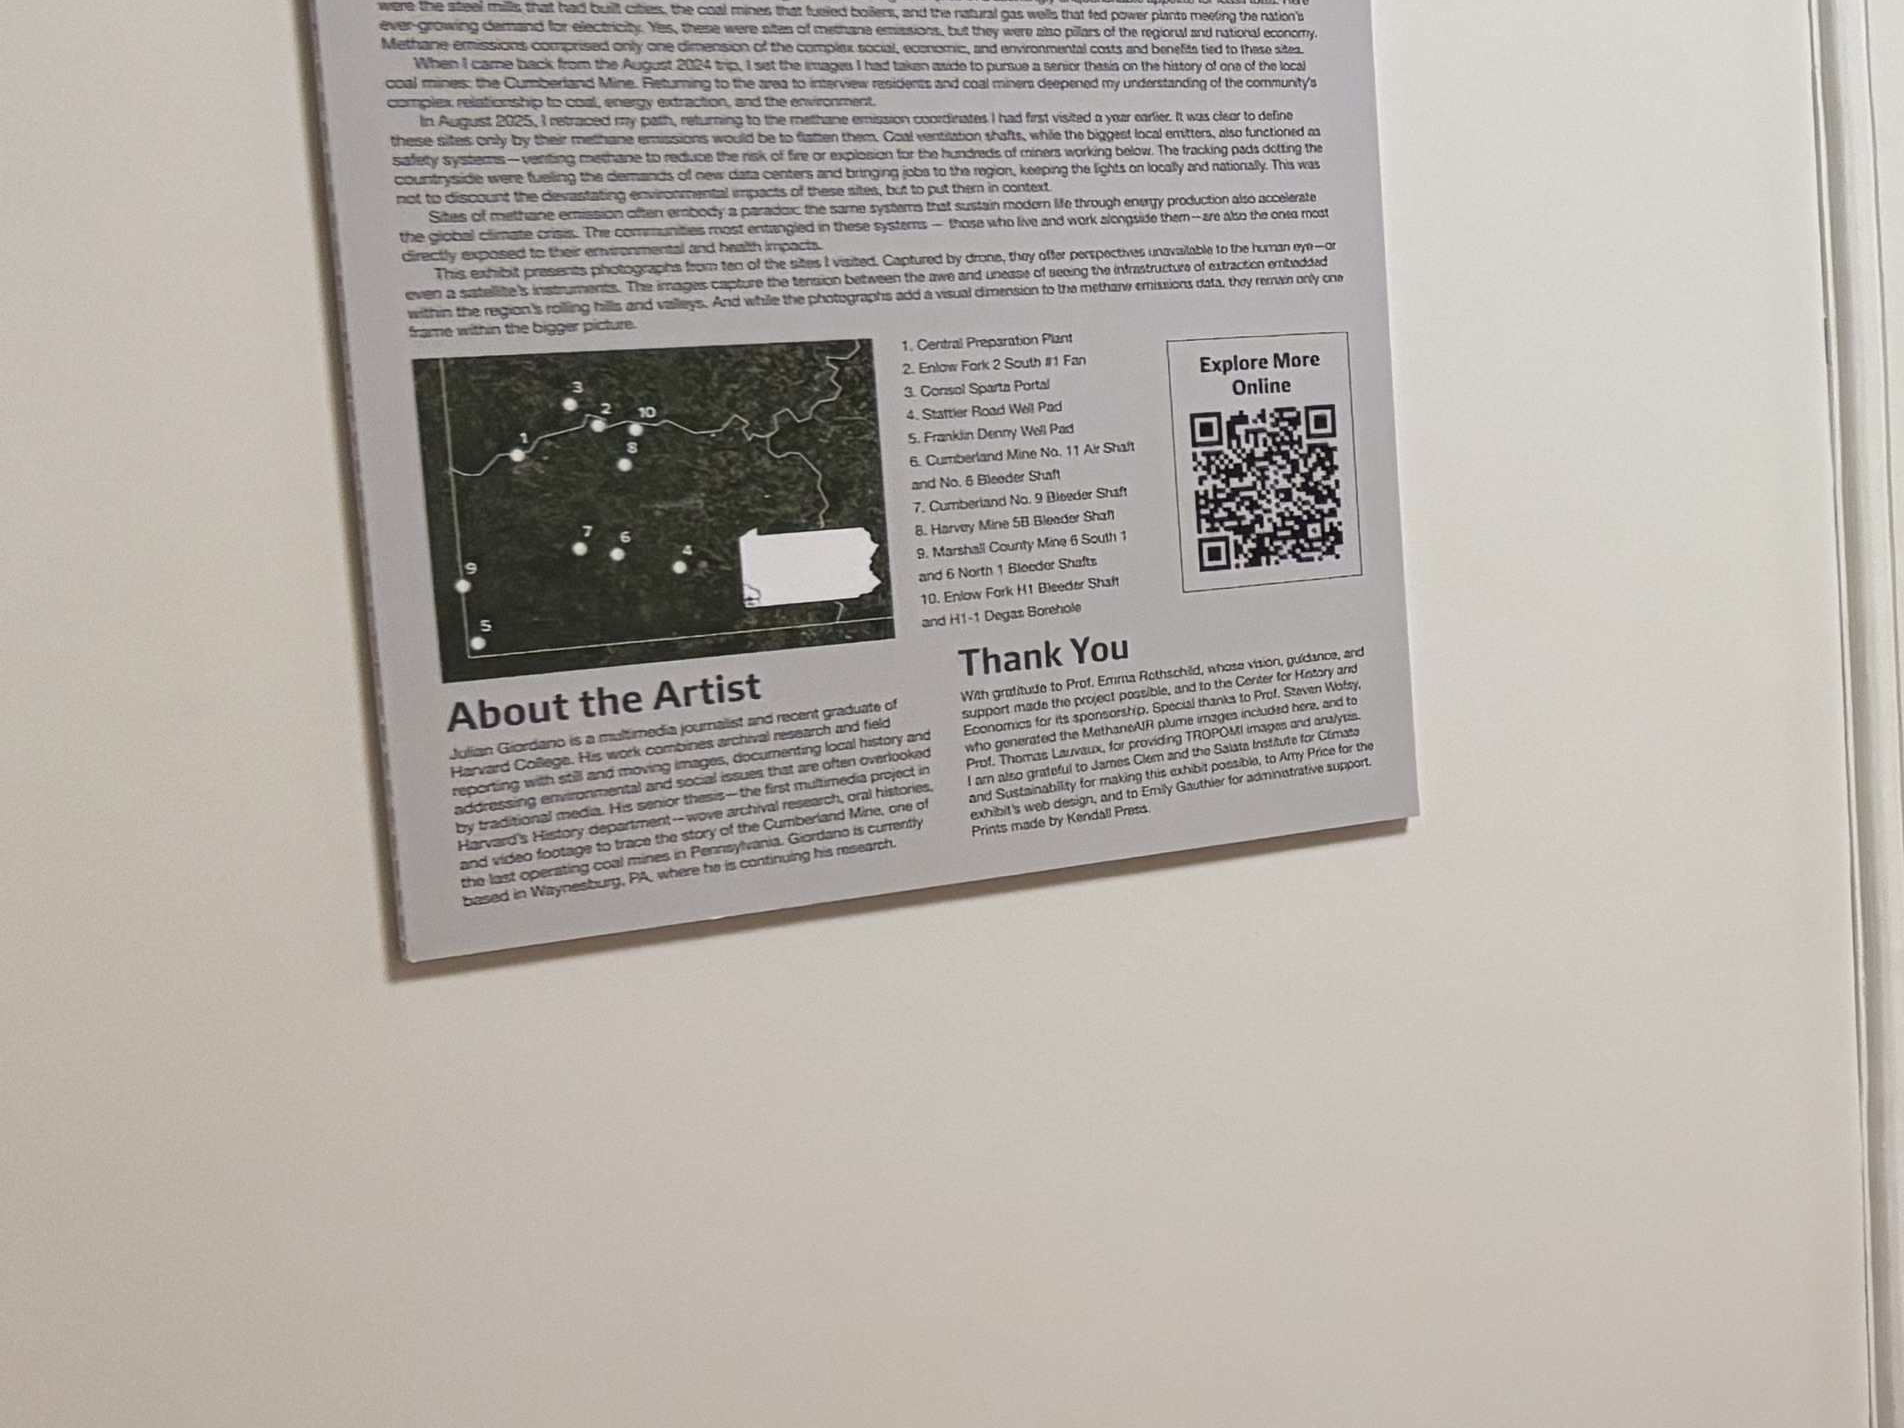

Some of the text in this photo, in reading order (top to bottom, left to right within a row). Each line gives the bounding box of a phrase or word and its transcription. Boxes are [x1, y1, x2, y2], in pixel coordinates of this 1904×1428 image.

[408, 319, 636, 338] frame within the bigger picture.
[901, 332, 1072, 351] 1. Central Preparation Plant
[902, 362, 914, 375] 2.
[918, 361, 957, 374] Enlow
[960, 359, 990, 371] Fork
[992, 358, 1000, 370] 2
[1003, 357, 1041, 369] South
[1063, 354, 1086, 366] Fan
[1199, 352, 1319, 375] Explore More
[571, 381, 583, 394] 3
[903, 378, 1050, 397] 3. Consol Sparta Portal
[1232, 377, 1291, 395] Online
[600, 402, 612, 416] 2
[638, 406, 657, 419] 10
[906, 409, 918, 420] 4.
[971, 403, 1005, 417] Road
[1008, 402, 1034, 414] Well
[1037, 400, 1062, 412] Pad
[519, 432, 528, 446] 1
[907, 422, 1074, 444] 5. Franklin Denny Well Pad
[626, 442, 638, 455] 8
[909, 440, 1134, 467] 6. Cumberland Mine No. 11 Air Shaft
[911, 468, 1060, 490] and No. 6 Bleeder Shaft
[913, 485, 1127, 512] 7. Cumberland No. 9 Bleeder Shaft
[581, 525, 593, 539] 7
[914, 524, 927, 536] 8.
[978, 518, 1009, 530] Mine
[1033, 512, 1079, 526] Bleeder
[1083, 509, 1114, 522] Shaft
[619, 531, 631, 544] 6
[916, 530, 1126, 559] 9. Marshall County Mine 6 South 1
[682, 544, 694, 557] 4
[465, 562, 478, 575] 9
[918, 555, 1097, 582] and 6 North 1 Bleeder Shafts
[920, 575, 1119, 604] 10. Enlow Fork H1 Bleeder Shaft
[480, 619, 492, 632] 5
[921, 615, 946, 628] and
[949, 611, 979, 624] H1-1
[957, 636, 1128, 676] Thank You
[446, 673, 761, 732] About the Artist
[448, 698, 897, 760] Julian Giordano is a multimedia journalist and recent graduate of
[971, 823, 1008, 836] Prints
[1010, 817, 1045, 831] made
[1048, 815, 1063, 827] by
